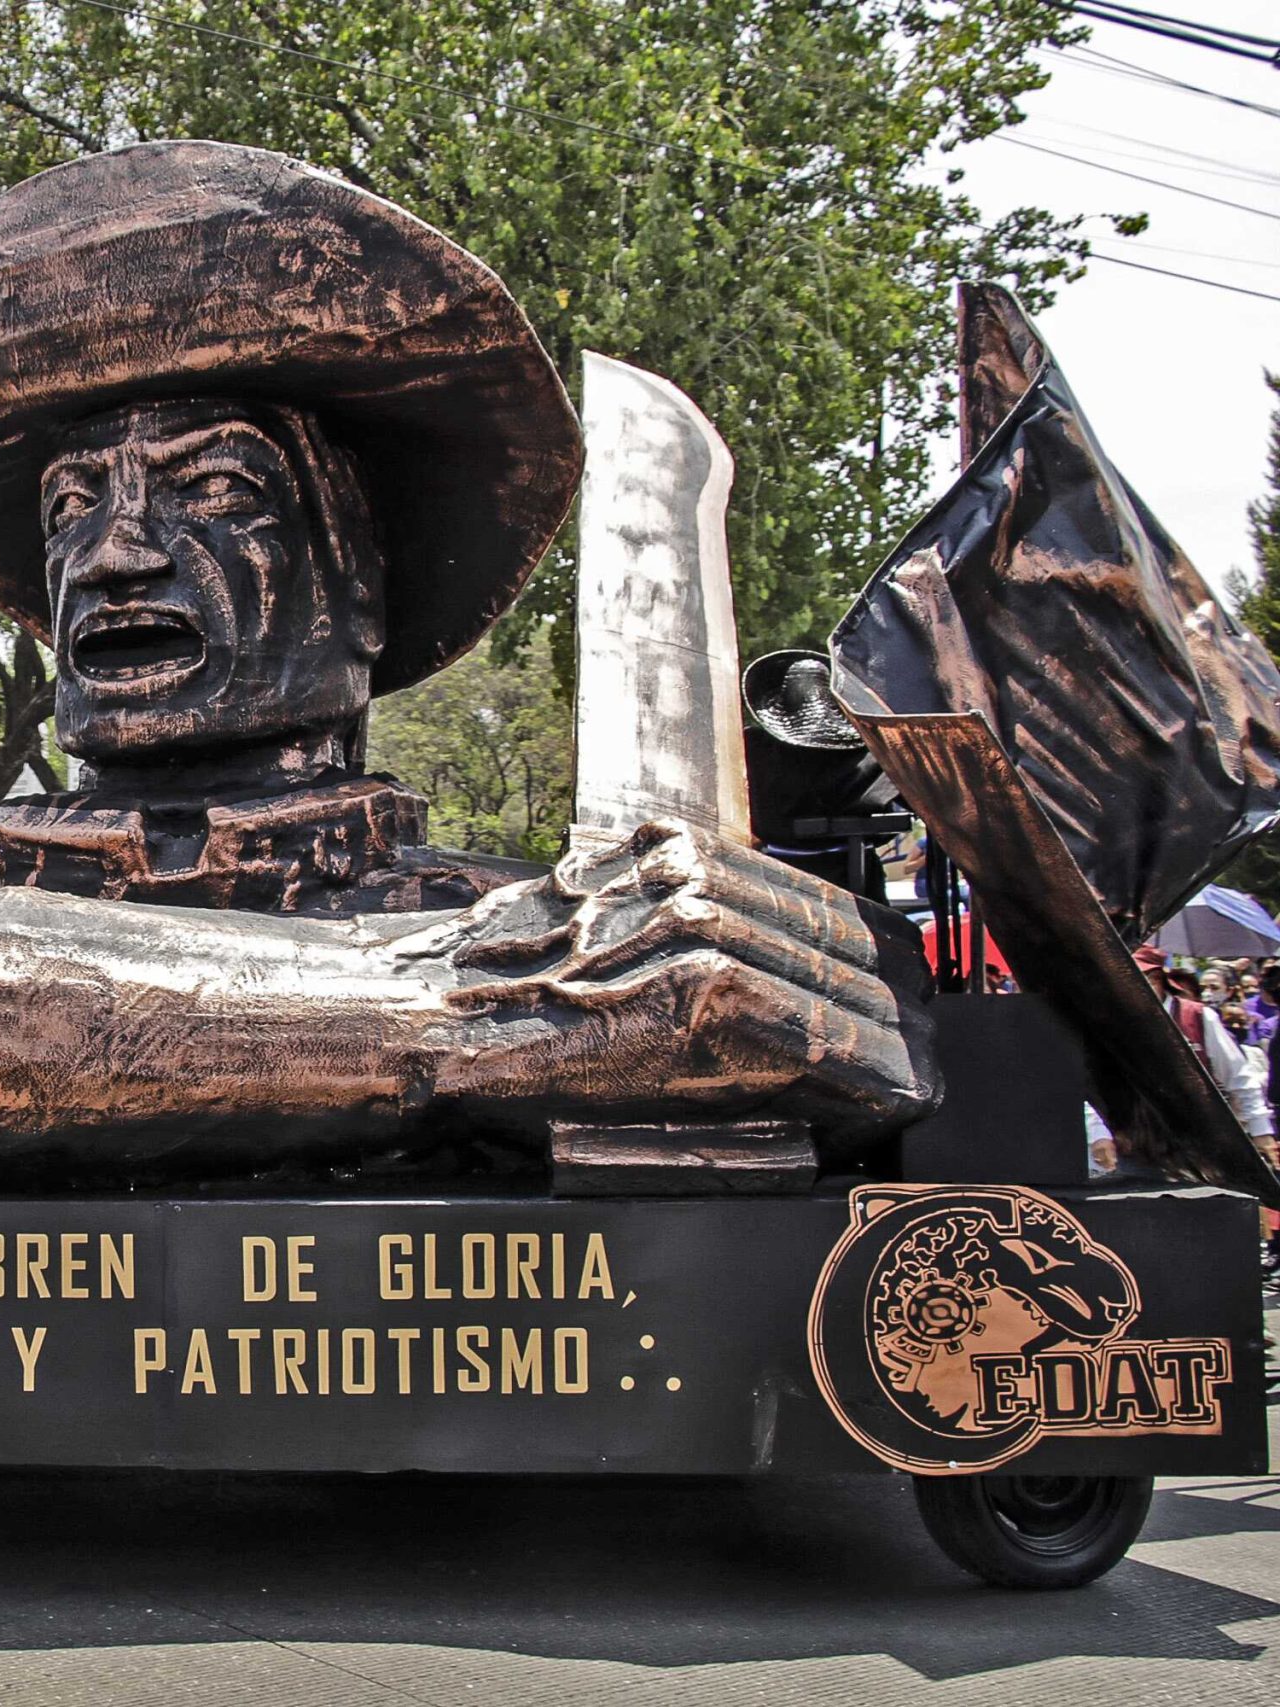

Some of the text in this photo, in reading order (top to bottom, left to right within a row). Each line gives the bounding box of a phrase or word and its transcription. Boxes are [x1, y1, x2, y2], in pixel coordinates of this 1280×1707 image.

[242, 1235, 319, 1303] DE
[378, 1232, 638, 1308] GLORIA,
[10, 1327, 49, 1392] Y
[133, 1325, 590, 1396] PATRIOTISMO
[971, 1343, 1227, 1424] EDAT
